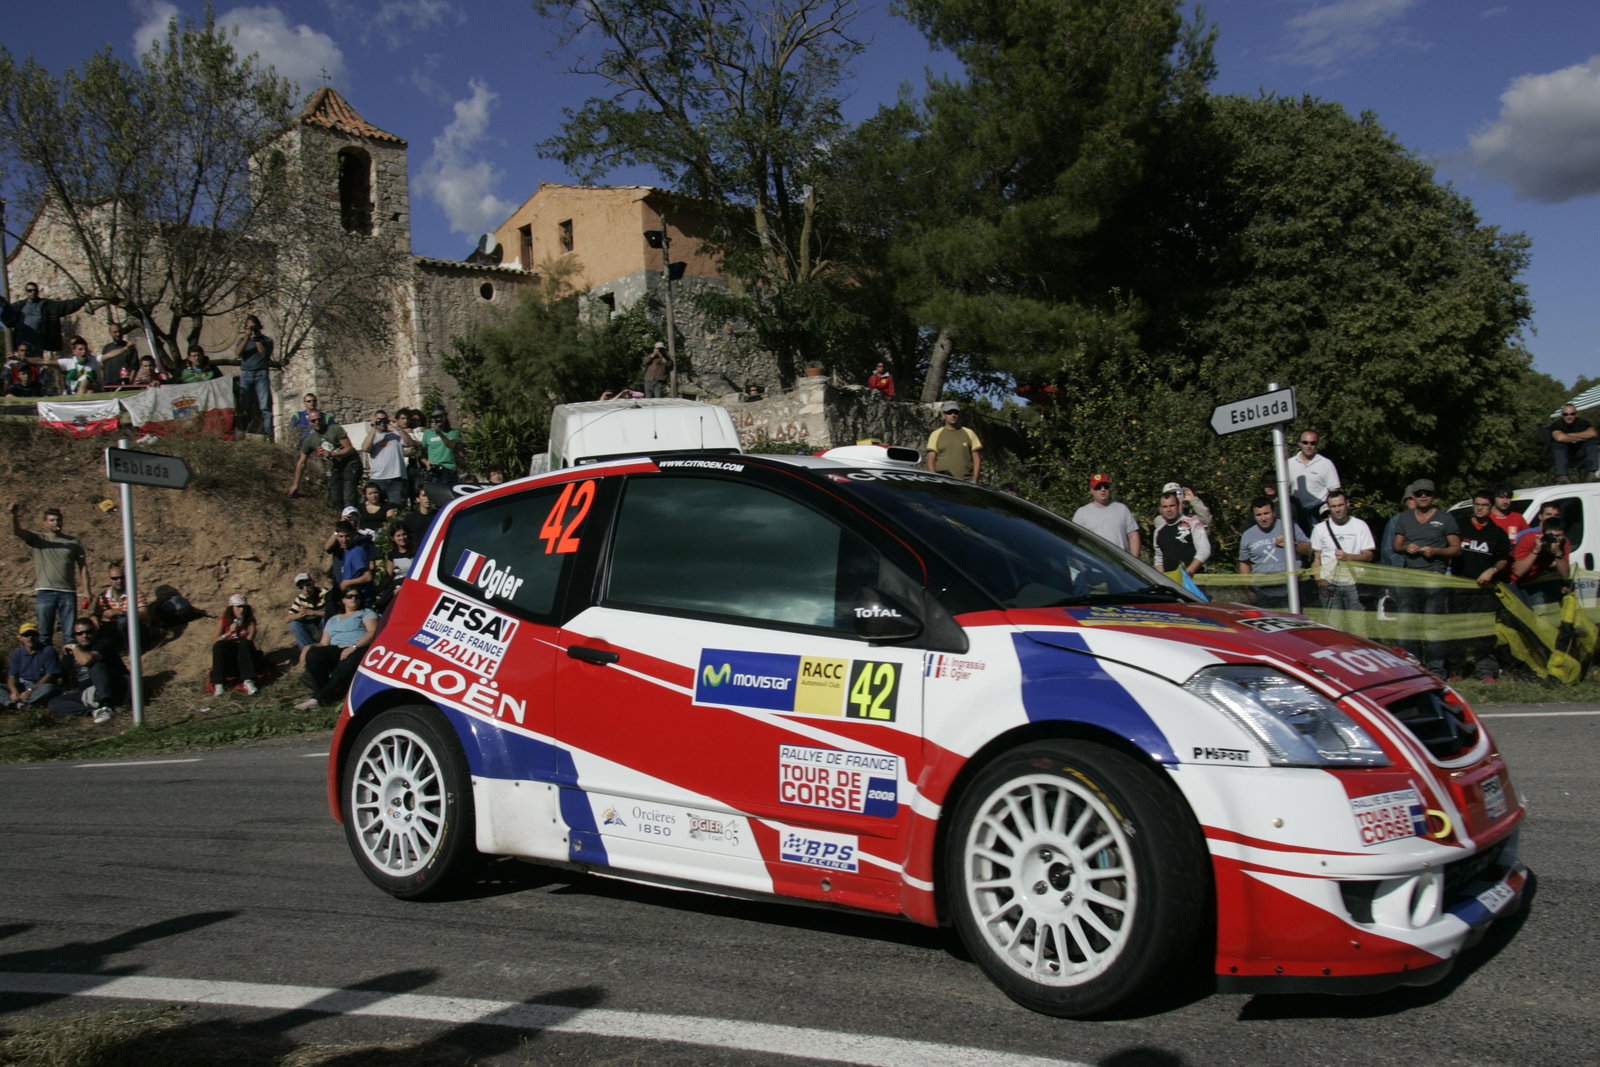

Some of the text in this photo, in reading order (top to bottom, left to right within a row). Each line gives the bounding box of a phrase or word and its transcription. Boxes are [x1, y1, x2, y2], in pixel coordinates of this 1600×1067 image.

[1231, 400, 1288, 424] Esblada
[114, 458, 169, 479] Esblada
[659, 460, 744, 472] WWW.CITROEN.COM
[539, 479, 595, 554] 42
[478, 559, 524, 600] Ogier
[432, 595, 503, 641] FFSA
[854, 606, 901, 618] TOTAL
[453, 630, 466, 642] DE
[466, 635, 503, 658] FRANCE
[433, 638, 498, 676] RALLYE
[802, 661, 844, 679] RACC
[951, 668, 971, 681] Ogier
[364, 645, 527, 724] CITROËN
[850, 662, 895, 720] 42
[781, 747, 896, 771] RALLYE DE FRANCE
[781, 764, 862, 789] TOUR DE
[781, 781, 862, 811] CORSE
[867, 789, 896, 801] 2008
[632, 806, 676, 825] Orcières
[690, 817, 723, 834] OGIER
[1355, 809, 1390, 826] TOUR
[638, 823, 671, 836] 1850
[1362, 819, 1415, 843] CORSE
[805, 840, 854, 860] BPS
[801, 857, 849, 869] RACING
